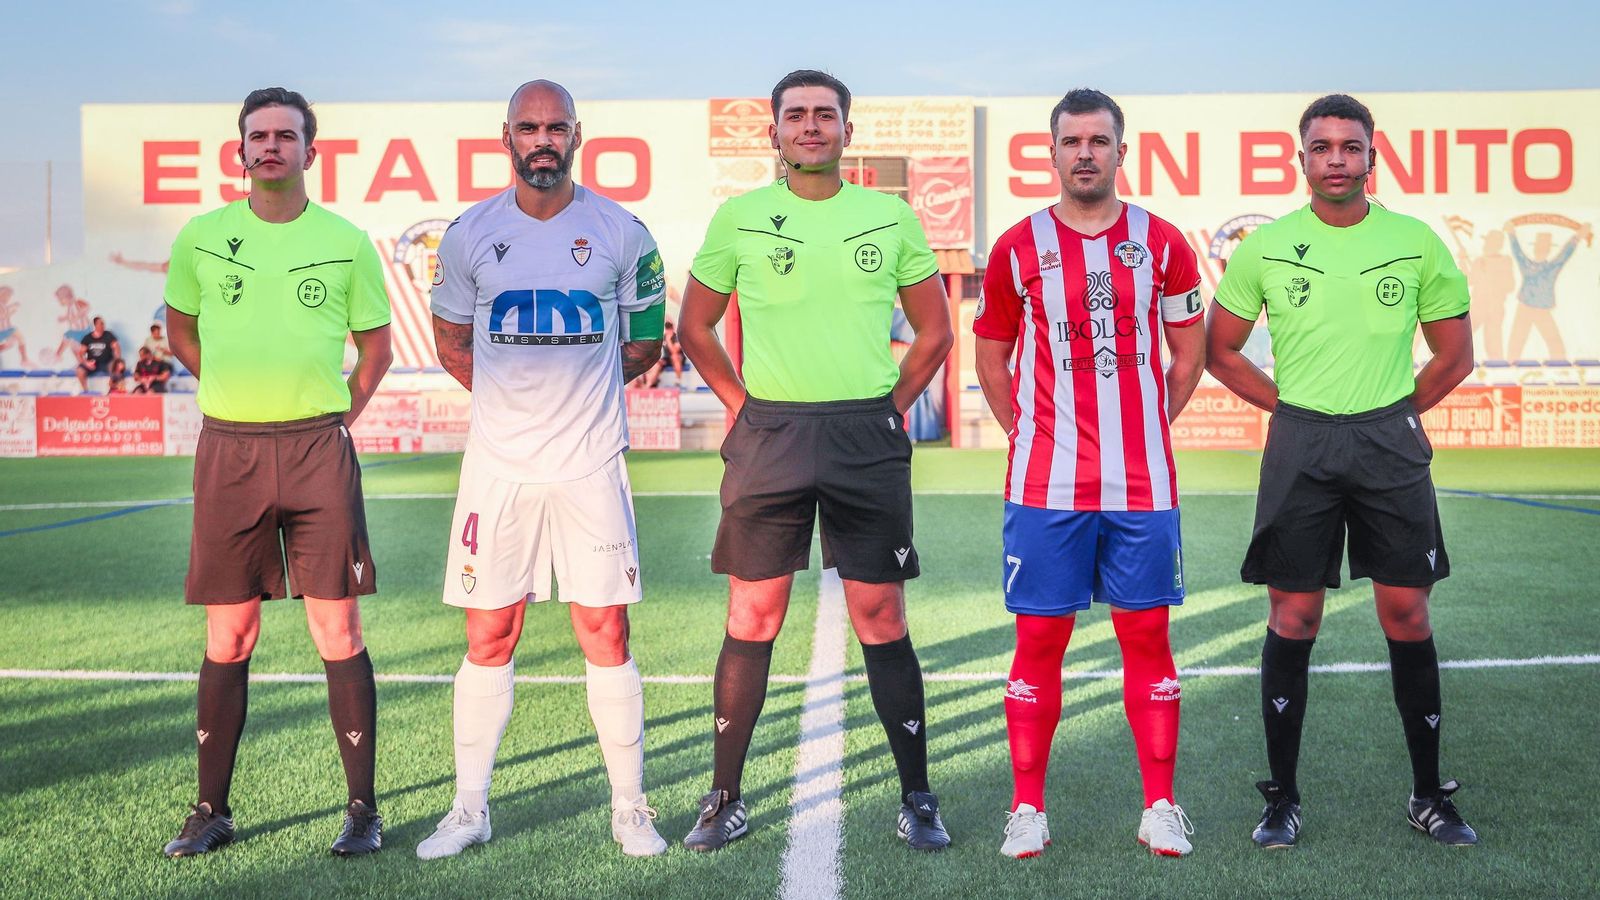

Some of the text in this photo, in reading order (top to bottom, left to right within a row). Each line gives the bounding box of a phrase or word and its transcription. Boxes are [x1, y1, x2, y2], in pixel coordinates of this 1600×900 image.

[1008, 129, 1574, 198] SN BNITO
[1185, 291, 1201, 314] C
[43, 416, 105, 433] Delgado
[63, 432, 142, 443] ABOGADOS
[461, 511, 480, 556] 4
[1006, 554, 1022, 593] 7
